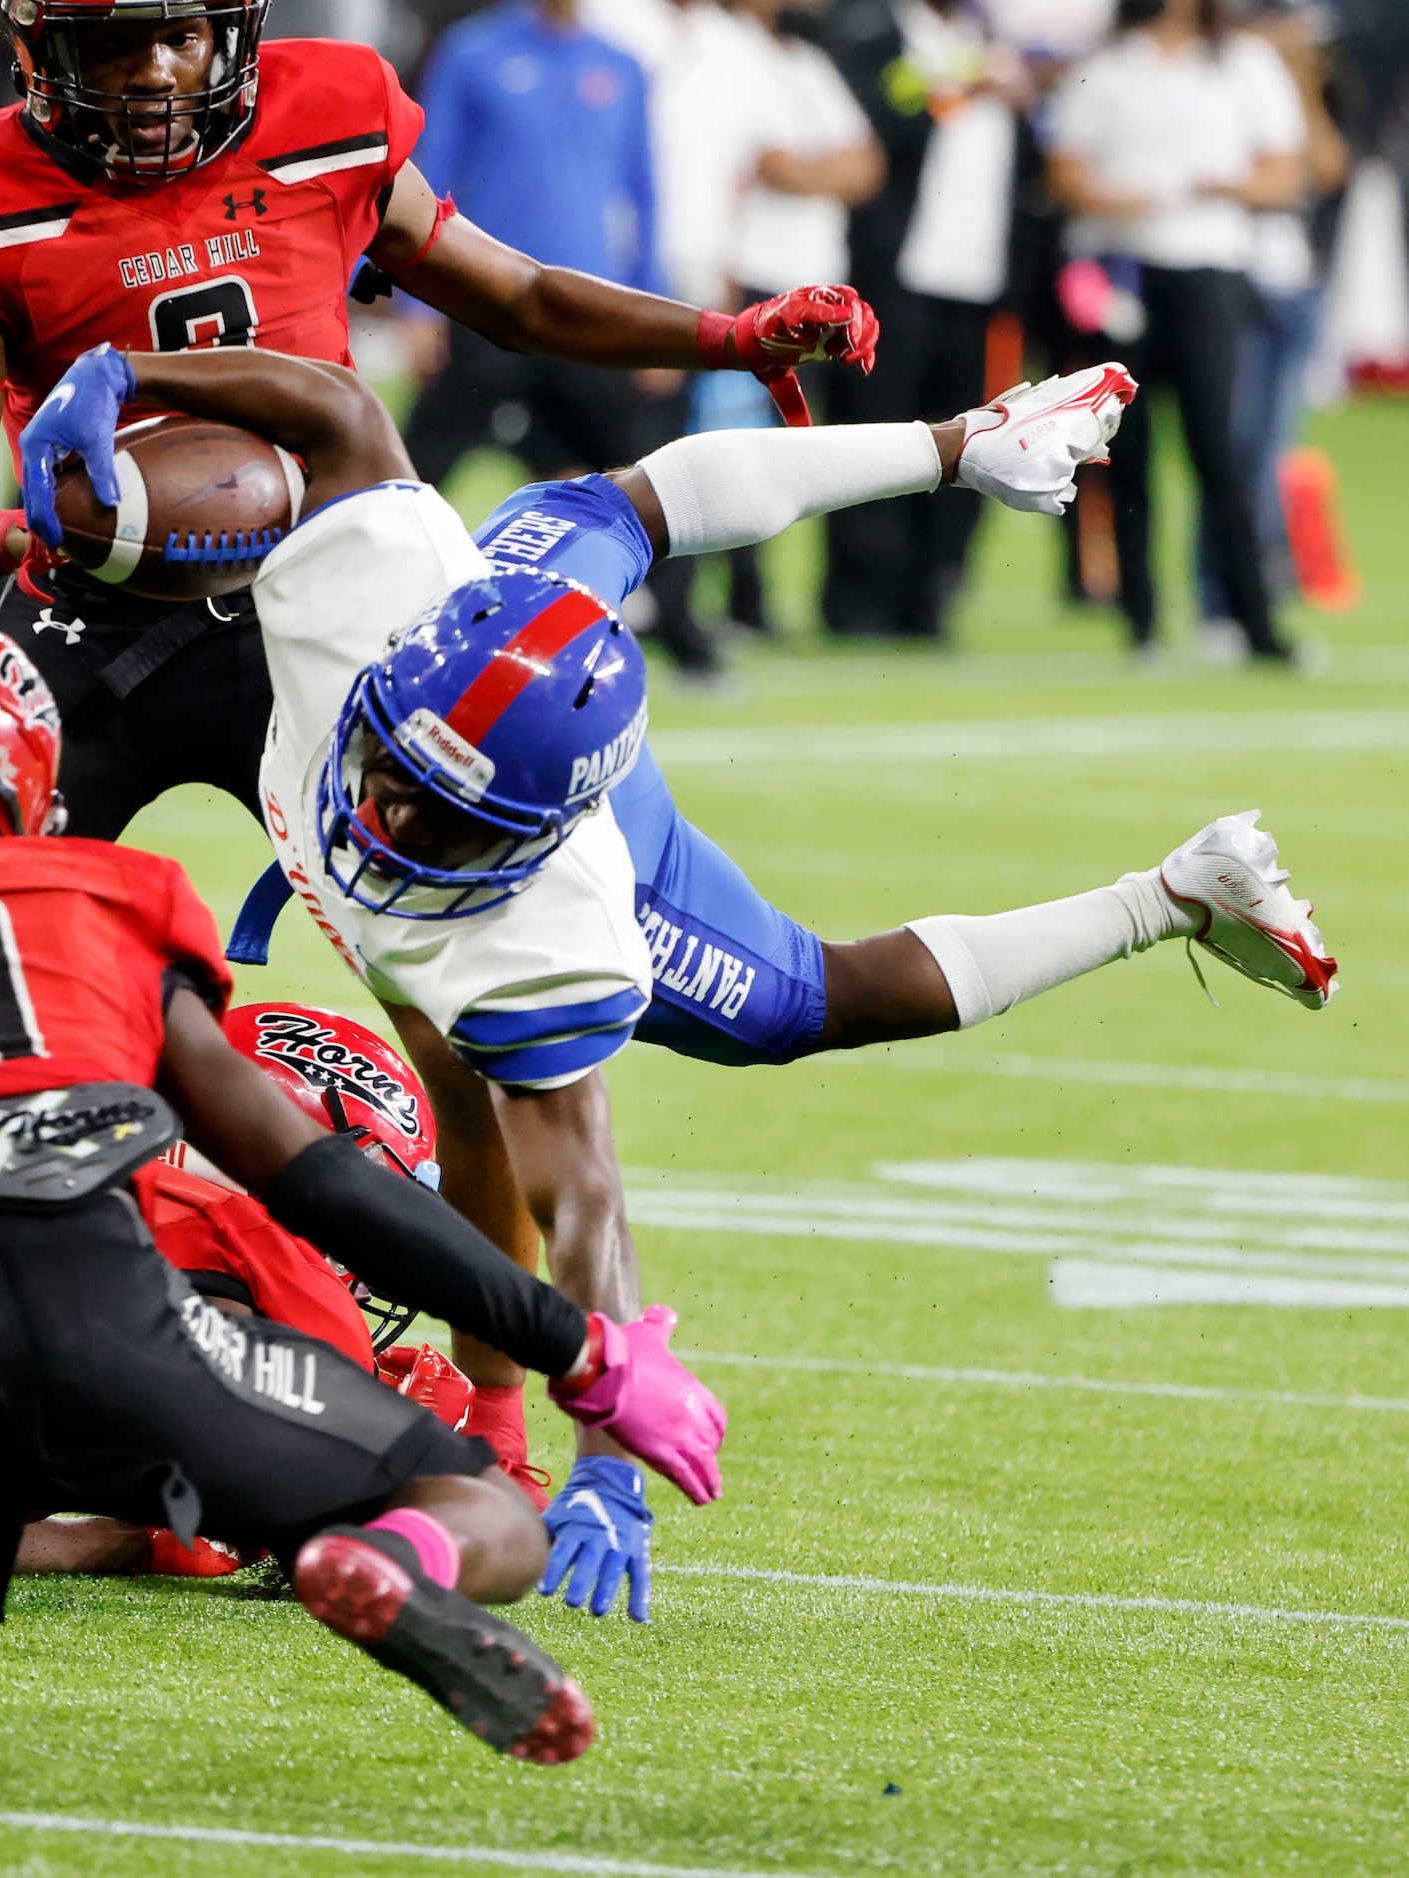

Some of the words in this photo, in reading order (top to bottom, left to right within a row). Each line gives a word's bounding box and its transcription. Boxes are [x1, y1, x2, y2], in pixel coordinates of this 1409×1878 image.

[118, 243, 199, 289] CEDAR
[204, 229, 261, 268] HILL
[428, 725, 476, 768] Riddell
[255, 1012, 421, 1139] Horns
[254, 1342, 326, 1415] HILL
